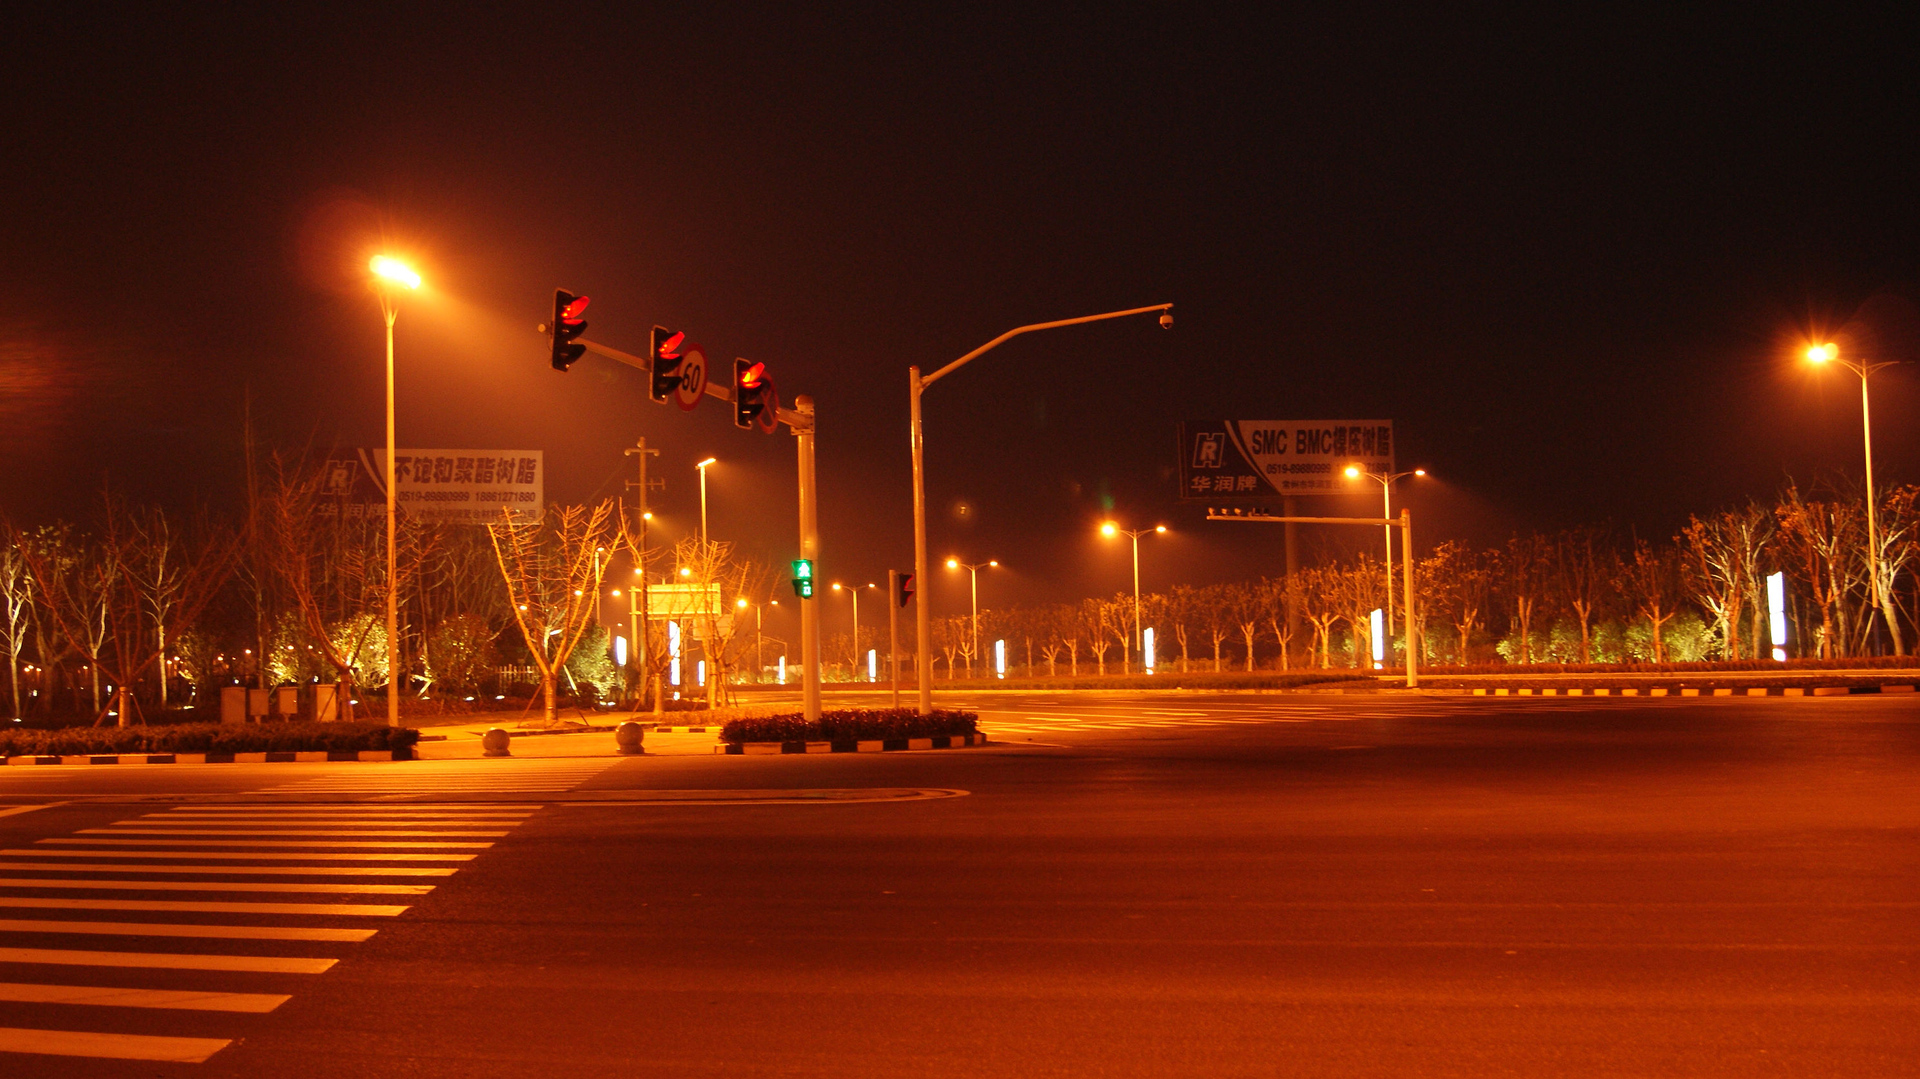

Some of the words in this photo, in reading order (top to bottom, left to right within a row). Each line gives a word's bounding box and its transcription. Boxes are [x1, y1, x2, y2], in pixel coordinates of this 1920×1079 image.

[682, 362, 700, 394] 60
[1251, 429, 1288, 455] SMC
[394, 456, 537, 484] 不饱和聚酯树脂
[1191, 475, 1257, 492] 华润牌
